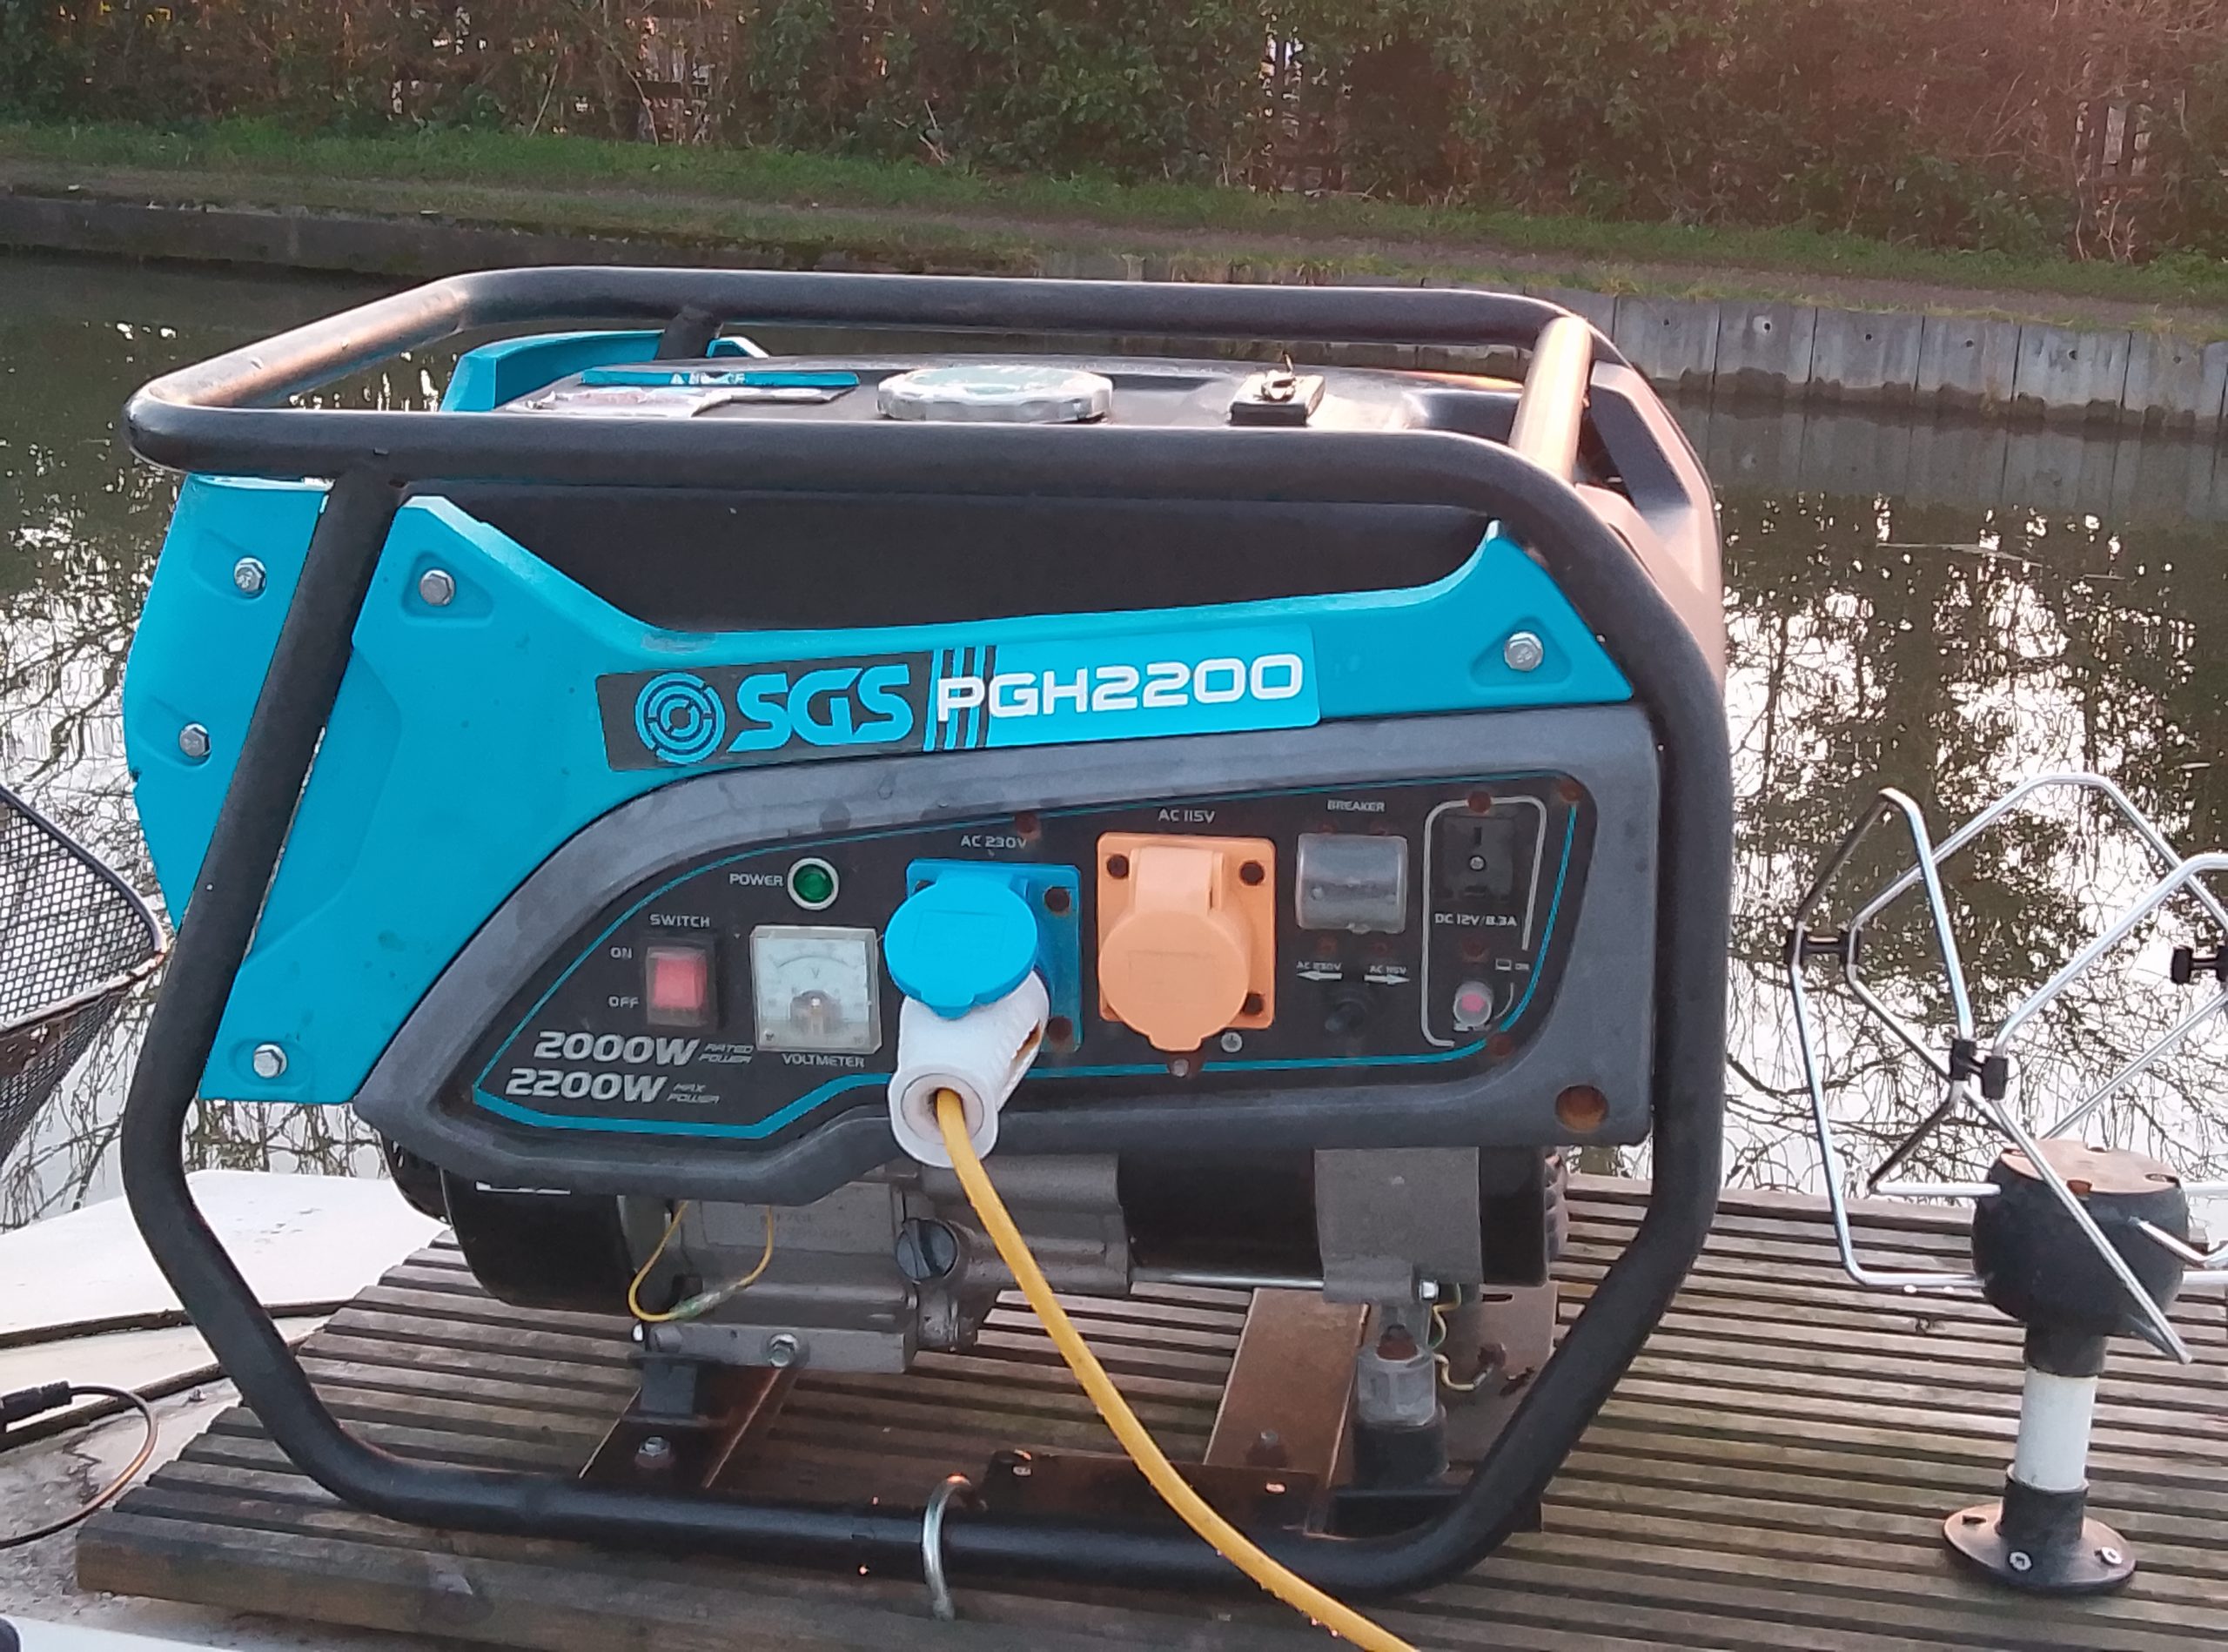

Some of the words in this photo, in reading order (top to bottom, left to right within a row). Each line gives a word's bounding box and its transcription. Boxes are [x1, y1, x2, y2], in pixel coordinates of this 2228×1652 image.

[937, 654, 1303, 722] PGH2200
[728, 664, 913, 752] SGS
[1327, 799, 1386, 812] BREAKER
[1158, 809, 1181, 821] AC
[1184, 809, 1216, 823] 115V
[960, 835, 982, 847] AC
[985, 836, 1027, 849] 230V
[729, 873, 783, 886] POWER
[649, 914, 710, 928] SWITCH
[1434, 913, 1454, 923] DC
[611, 947, 633, 958] ON
[608, 997, 639, 1009] OFF
[534, 1031, 700, 1065] 2000W
[699, 1054, 752, 1064] POWER
[782, 1053, 864, 1068] VOLTMETER
[505, 1068, 668, 1103] 2200W
[667, 1093, 720, 1104] POWER
